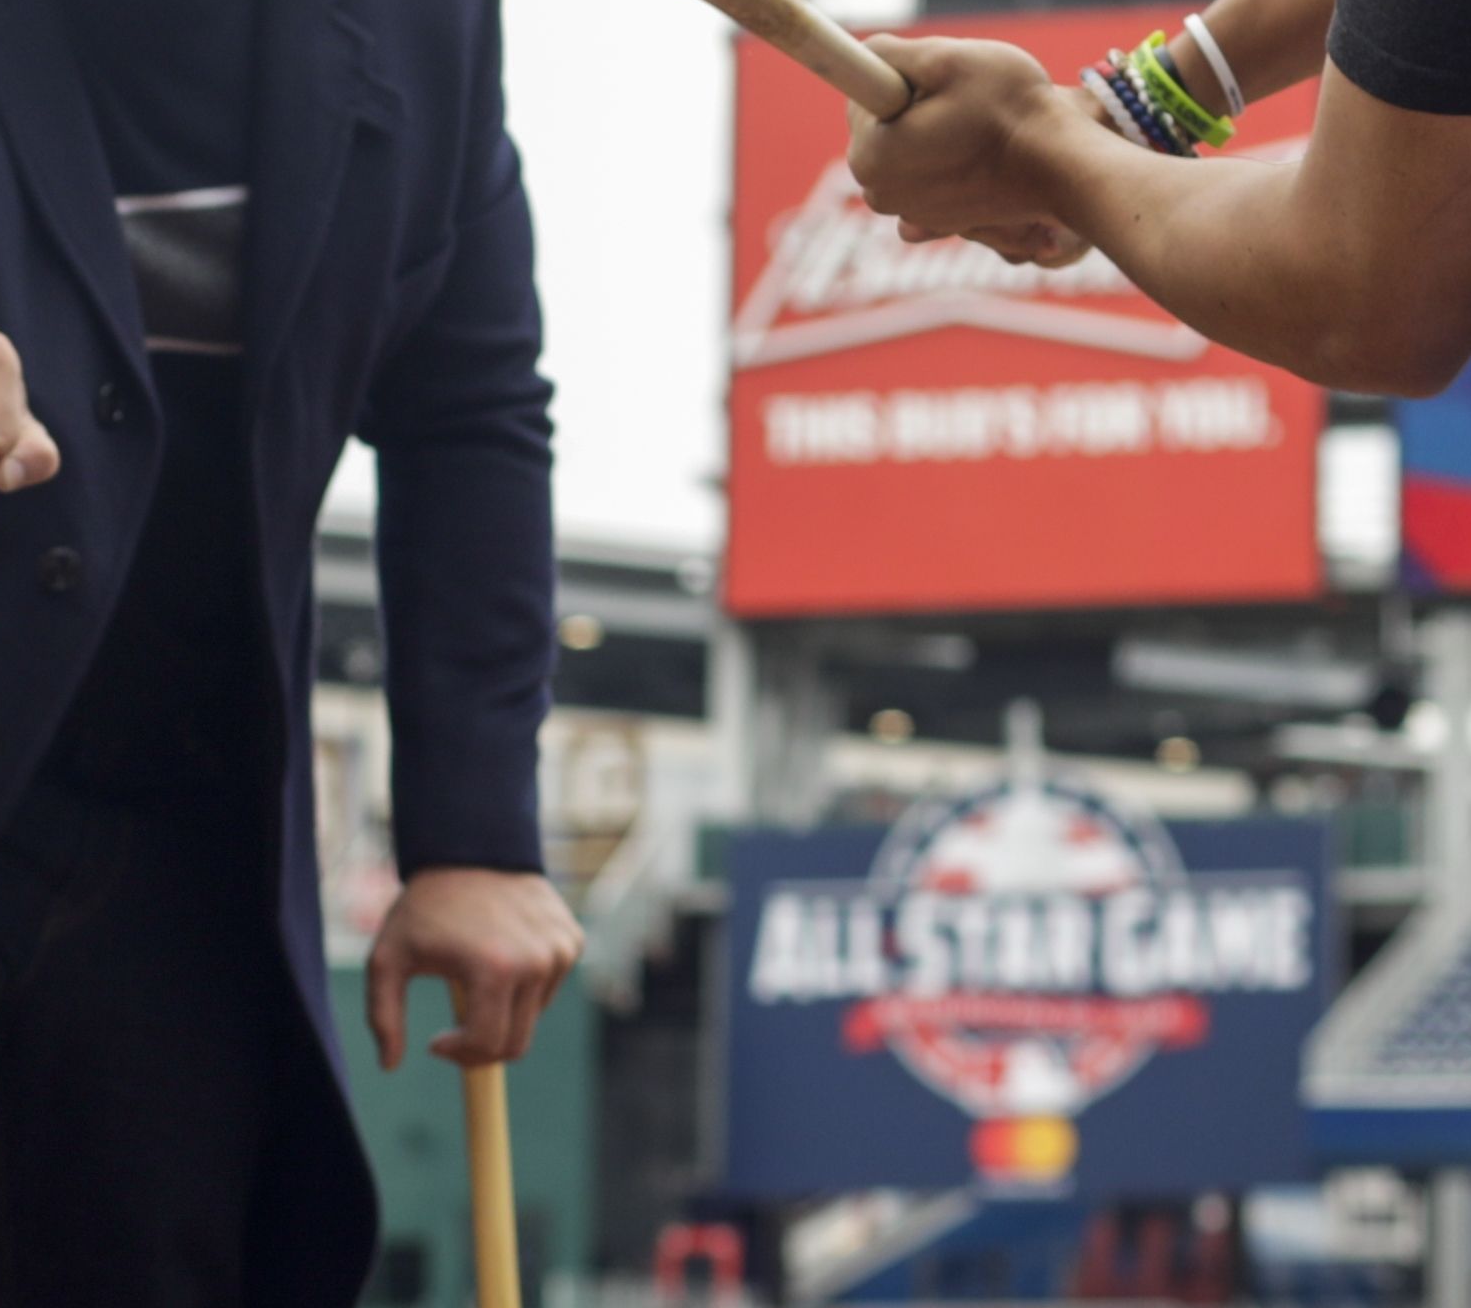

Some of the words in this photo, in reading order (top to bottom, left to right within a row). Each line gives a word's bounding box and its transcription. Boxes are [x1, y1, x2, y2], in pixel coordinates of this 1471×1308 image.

[763, 388, 877, 465] THIS
[750, 894, 890, 1002] ALL
[894, 884, 1094, 997] STAR
[1102, 882, 1313, 994] GAME
